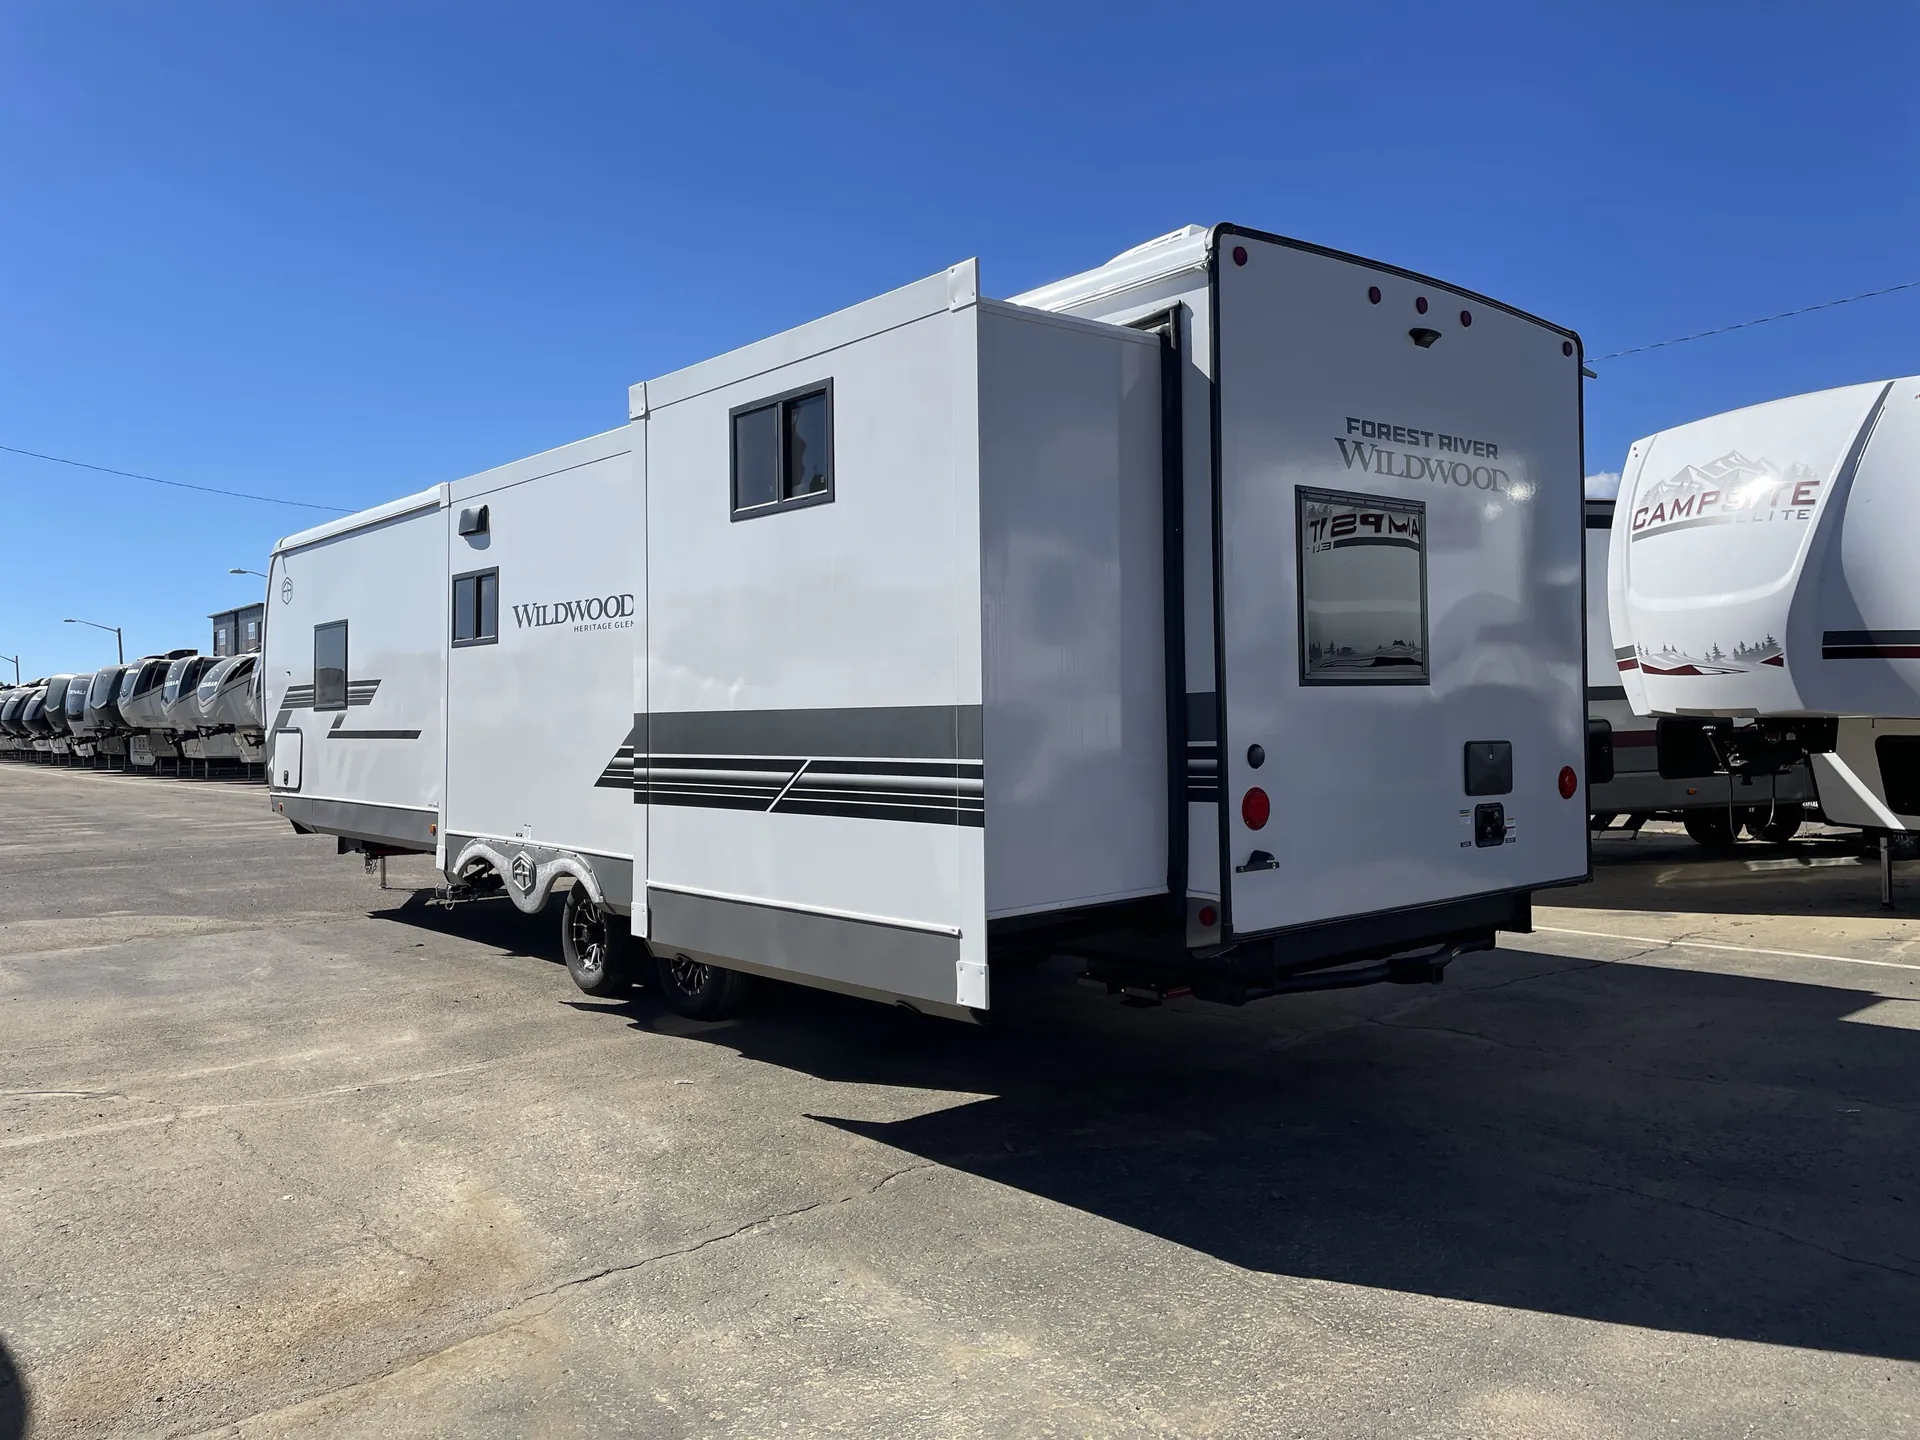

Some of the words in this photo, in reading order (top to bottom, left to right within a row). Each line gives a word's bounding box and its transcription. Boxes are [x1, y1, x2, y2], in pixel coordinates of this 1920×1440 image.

[1346, 416, 1434, 448] FOREST
[1438, 434, 1499, 460] RIVER
[1334, 437, 1511, 492] WILDWOOD
[1735, 509, 1811, 524] LITE
[512, 593, 634, 629] WILDWOOD
[573, 622, 612, 633] HERITAGE
